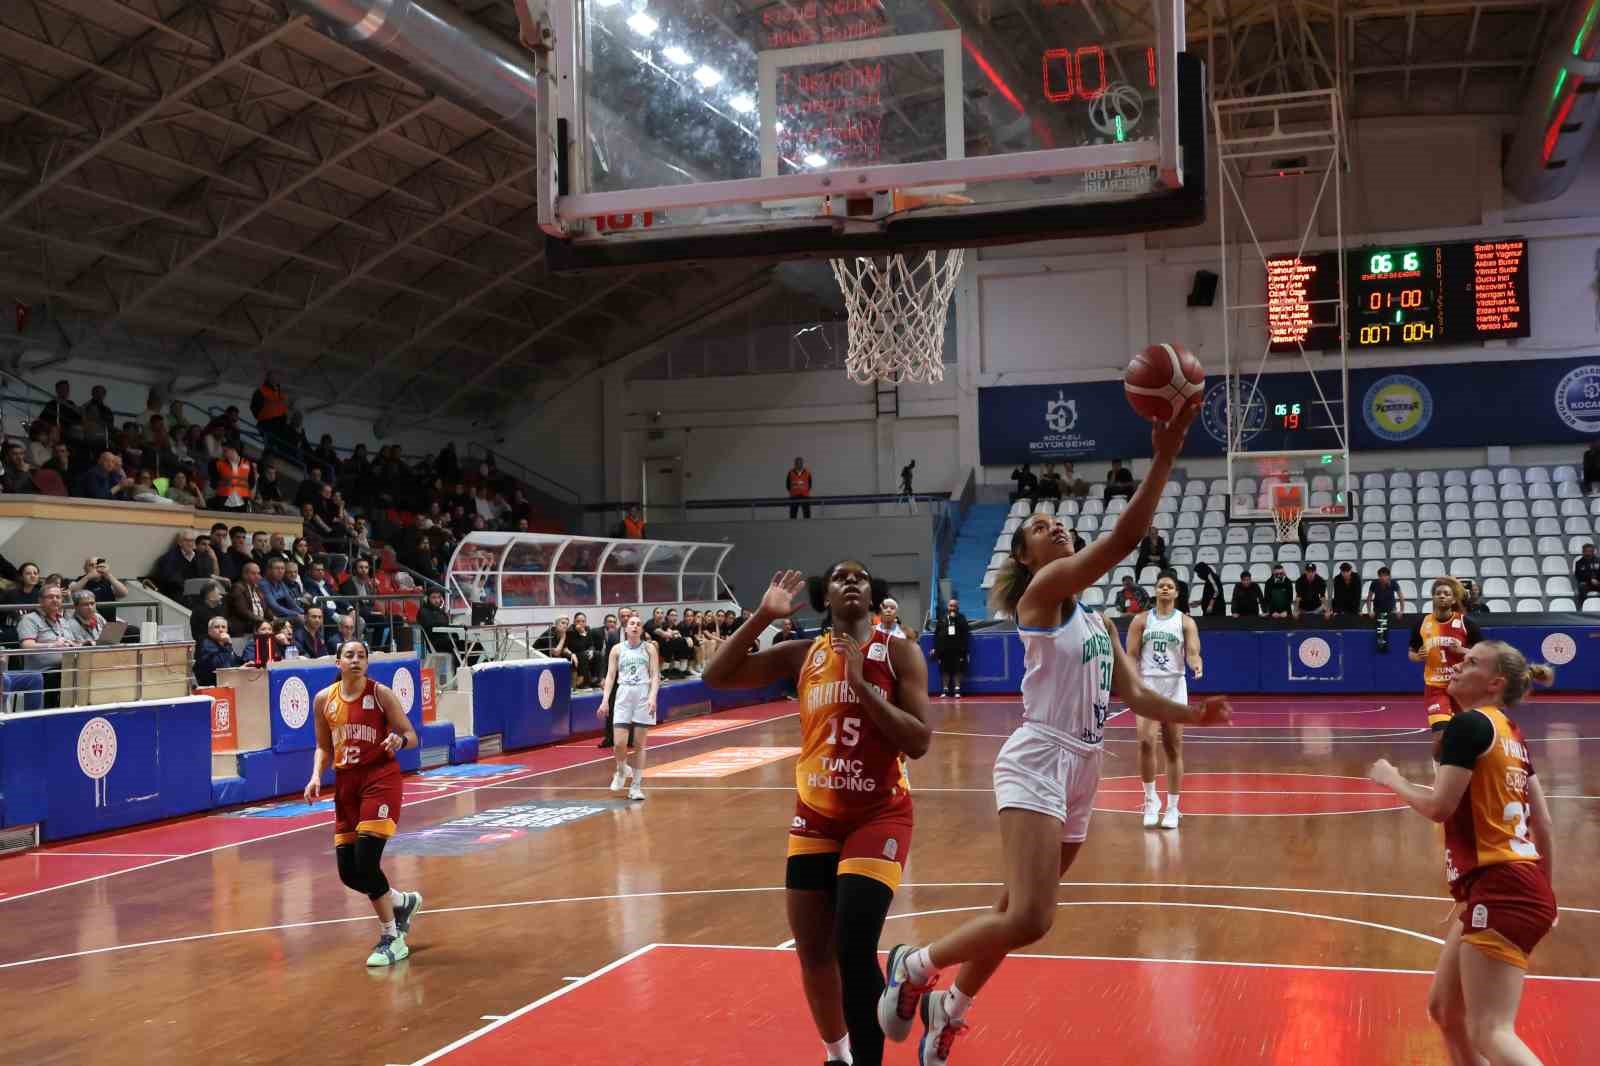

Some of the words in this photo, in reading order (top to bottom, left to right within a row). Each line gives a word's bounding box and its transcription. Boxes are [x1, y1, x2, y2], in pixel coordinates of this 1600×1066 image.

[1371, 254, 1392, 273] 06
[1370, 292, 1391, 310] 01
[1401, 290, 1421, 308] 00
[1396, 309, 1402, 323] 1
[1360, 326, 1390, 344] 007
[1403, 323, 1434, 341] 004
[1153, 640, 1168, 653] 00
[1439, 649, 1447, 663] 1
[1100, 660, 1112, 691] 31
[826, 717, 861, 747] 15
[821, 757, 865, 778] TUNÇ
[808, 772, 877, 792] HOLDİNG
